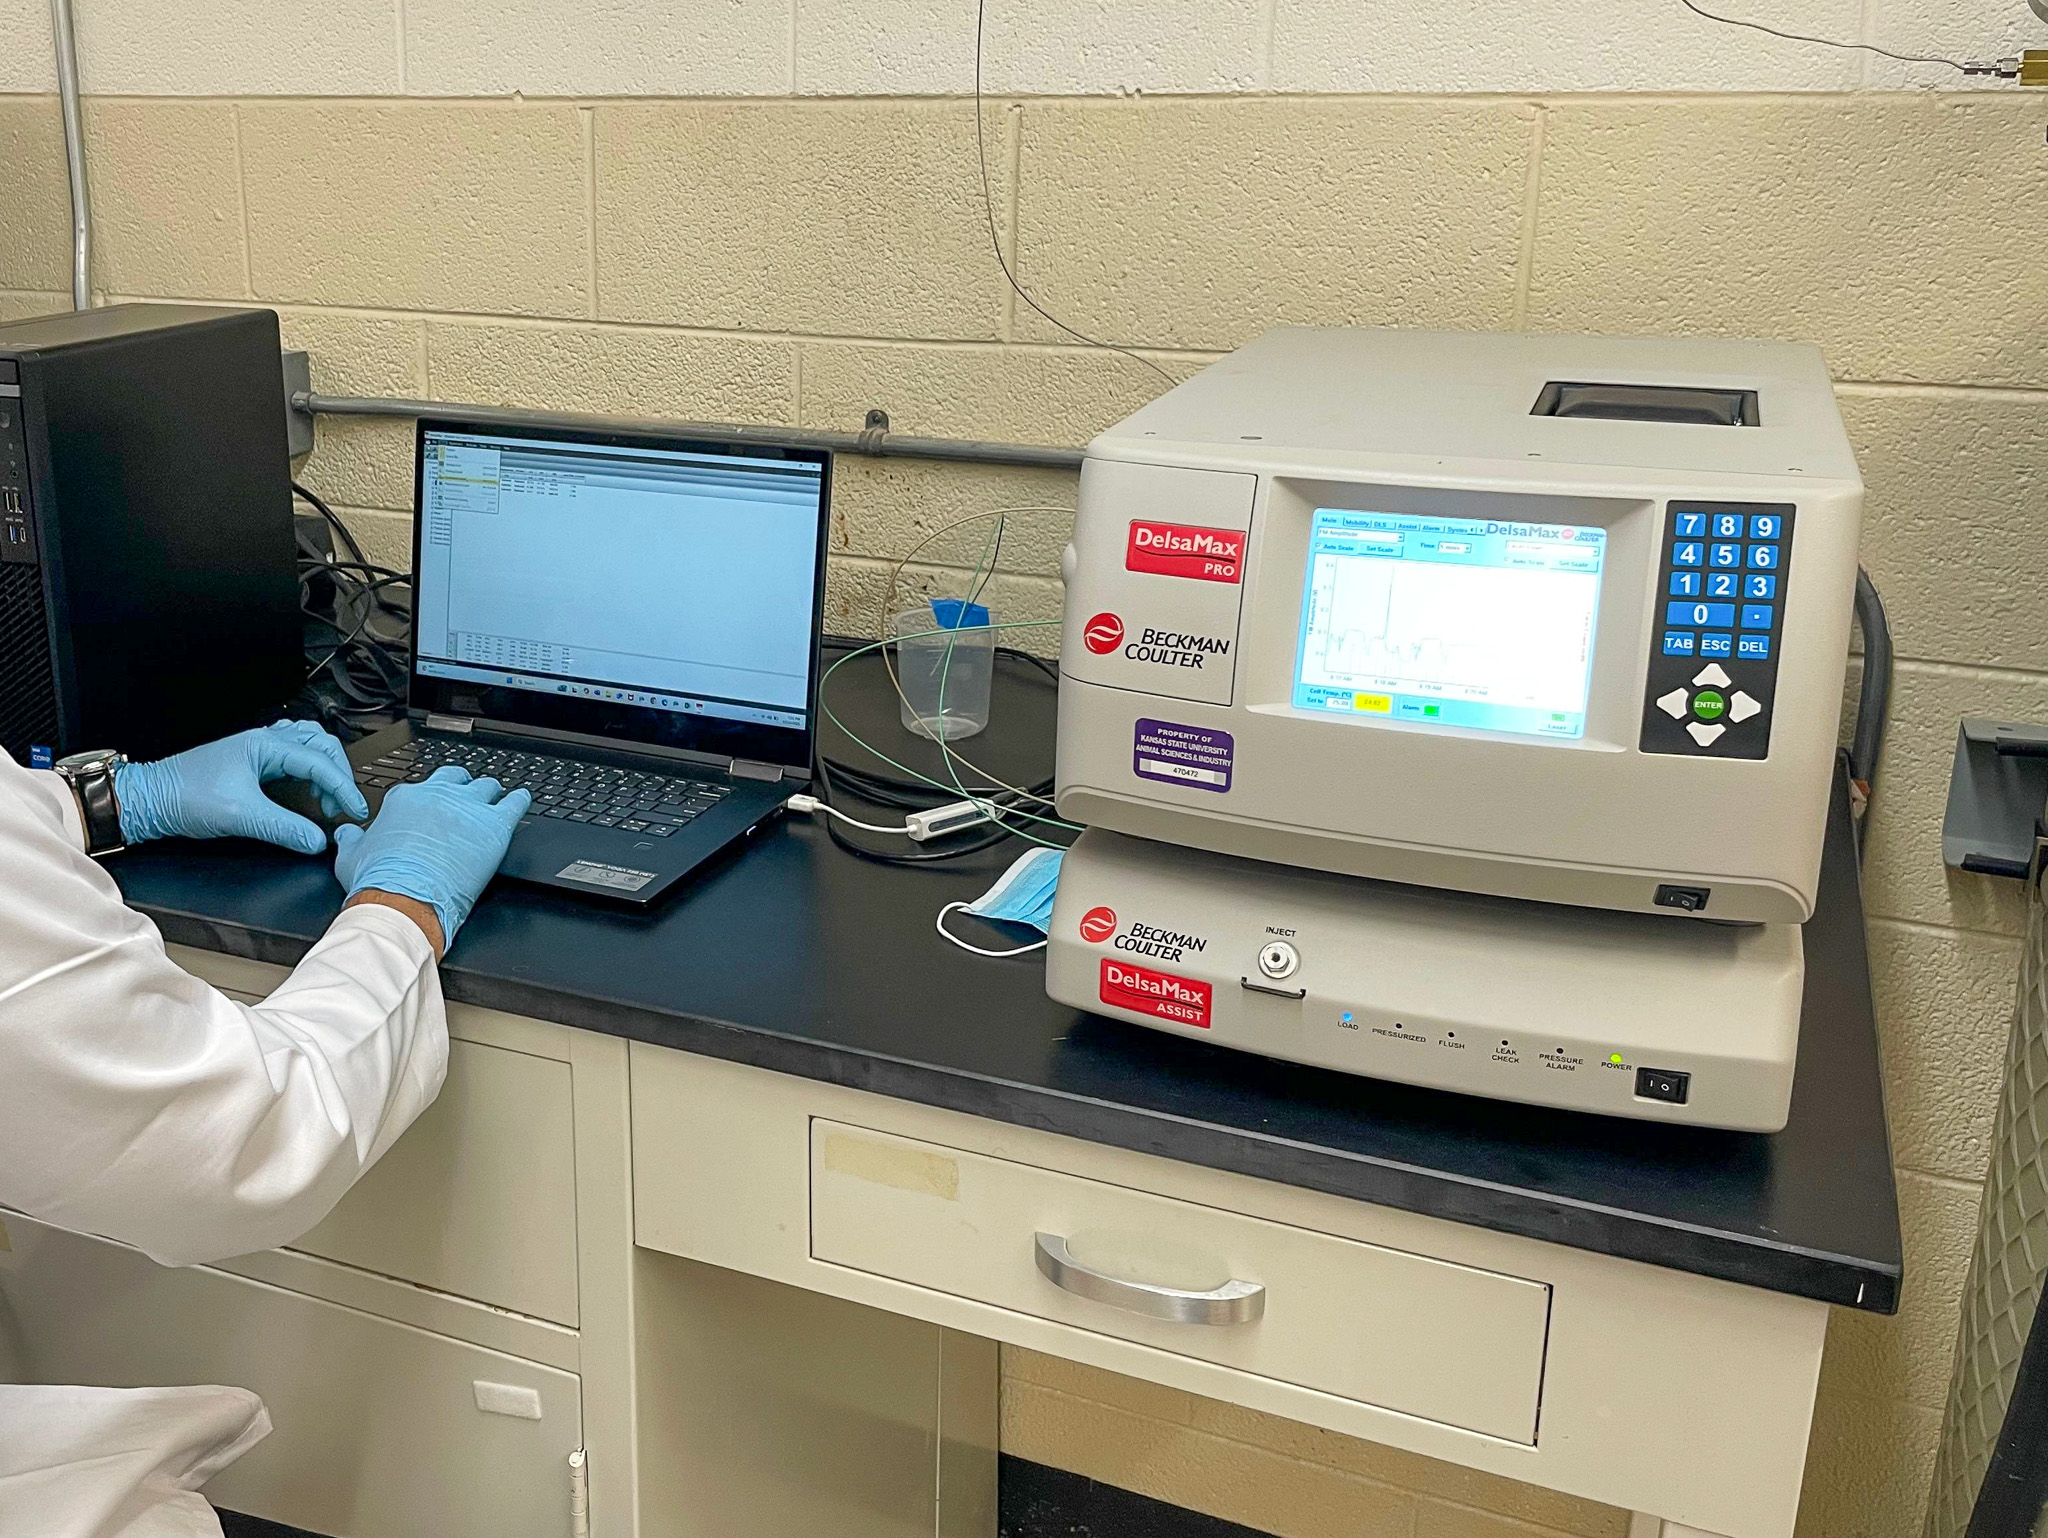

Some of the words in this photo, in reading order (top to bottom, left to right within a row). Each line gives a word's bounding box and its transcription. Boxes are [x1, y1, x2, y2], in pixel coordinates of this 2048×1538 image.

[1345, 519, 1370, 528] Mobility
[1486, 523, 1560, 539] DelsaMax
[1683, 515, 1698, 534] 7
[1720, 516, 1735, 536] 8
[1757, 517, 1773, 537] 9
[1135, 527, 1238, 556] DelsaMax
[1680, 544, 1696, 564] 4
[1717, 545, 1733, 565] 5
[1755, 546, 1770, 567] 6
[1204, 562, 1235, 577] PRO
[1680, 574, 1691, 594] 1
[1715, 575, 1730, 595] 2
[1752, 576, 1767, 597] 3
[1693, 604, 1708, 624] 0
[1141, 628, 1230, 655] BECKMAN
[1665, 637, 1694, 649] TAB
[1701, 639, 1731, 651] ESC
[1739, 641, 1769, 653] DEL
[1125, 643, 1204, 669] COULTER
[1694, 701, 1723, 709] ENTER
[1157, 728, 1200, 741] PROPERTY
[1140, 734, 1167, 746] KANSAS
[1167, 739, 1188, 749] STATE
[1188, 743, 1229, 756] UNIVERSITY
[1135, 744, 1160, 755] ANIMAL
[1160, 748, 1192, 760] SCIENCES
[1198, 754, 1232, 767] INDUSTRY
[1173, 767, 1199, 778] 470472
[1130, 922, 1207, 952] BECKMAN
[1265, 926, 1297, 938] INJECT
[1114, 934, 1183, 963] COULTER
[1107, 965, 1204, 1005] DelsaMax
[1156, 1002, 1203, 1022] ASSIST
[1337, 1020, 1359, 1031] LOAD
[1371, 1028, 1427, 1043] PRESSURIZED
[1438, 1039, 1465, 1050] FLUSH
[1495, 1047, 1518, 1056] LEAK
[1491, 1054, 1520, 1065] CHECK
[1539, 1053, 1584, 1065] PRESSURE
[1545, 1062, 1576, 1072] ALARM
[1600, 1061, 1632, 1071] POWER
